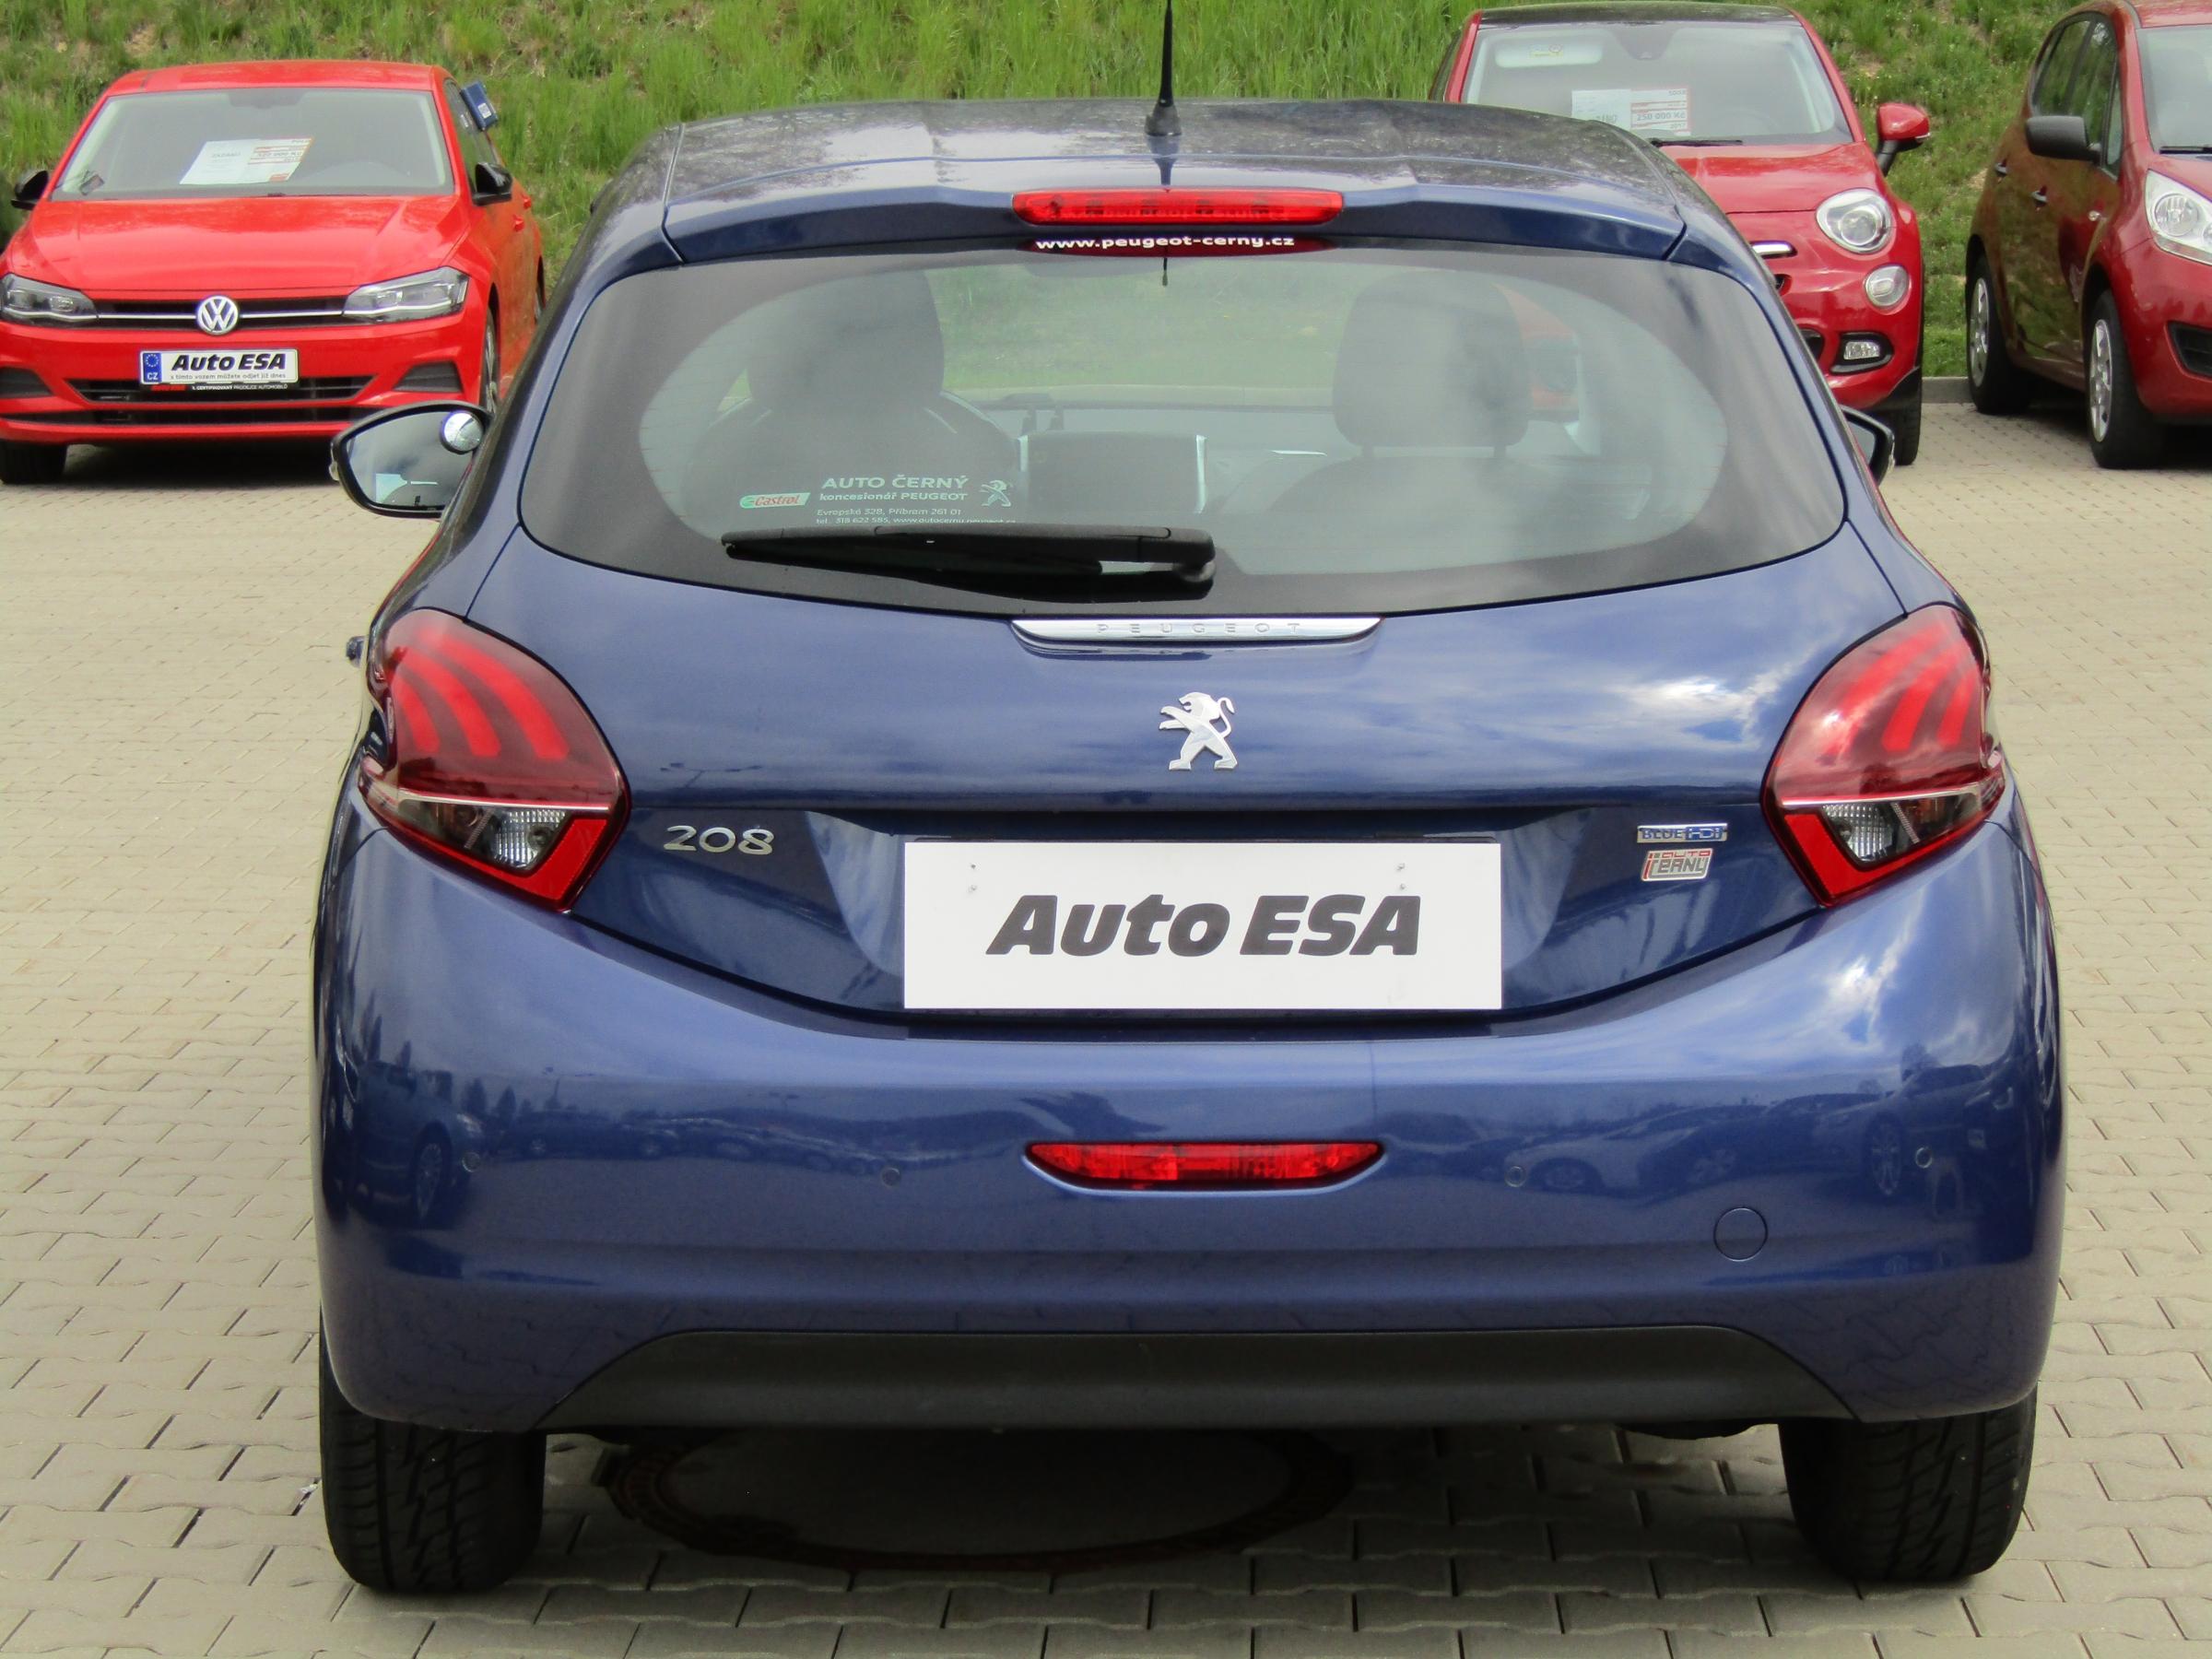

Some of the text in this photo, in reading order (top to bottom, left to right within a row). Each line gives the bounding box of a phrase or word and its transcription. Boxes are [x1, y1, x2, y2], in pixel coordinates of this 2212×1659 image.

[1035, 236, 1295, 250] www.peugeot-cerny.cz
[171, 353, 287, 371] Auto ESA
[147, 371, 159, 381] CZ
[821, 474, 969, 489] AUTO ČERNÝ
[755, 494, 801, 506] Castrol
[819, 492, 969, 501] koncesionář PEUGEOT
[1097, 623, 1300, 633] PEUGEOT
[663, 825, 775, 855] 208
[985, 894, 1421, 958] Auto ESA
